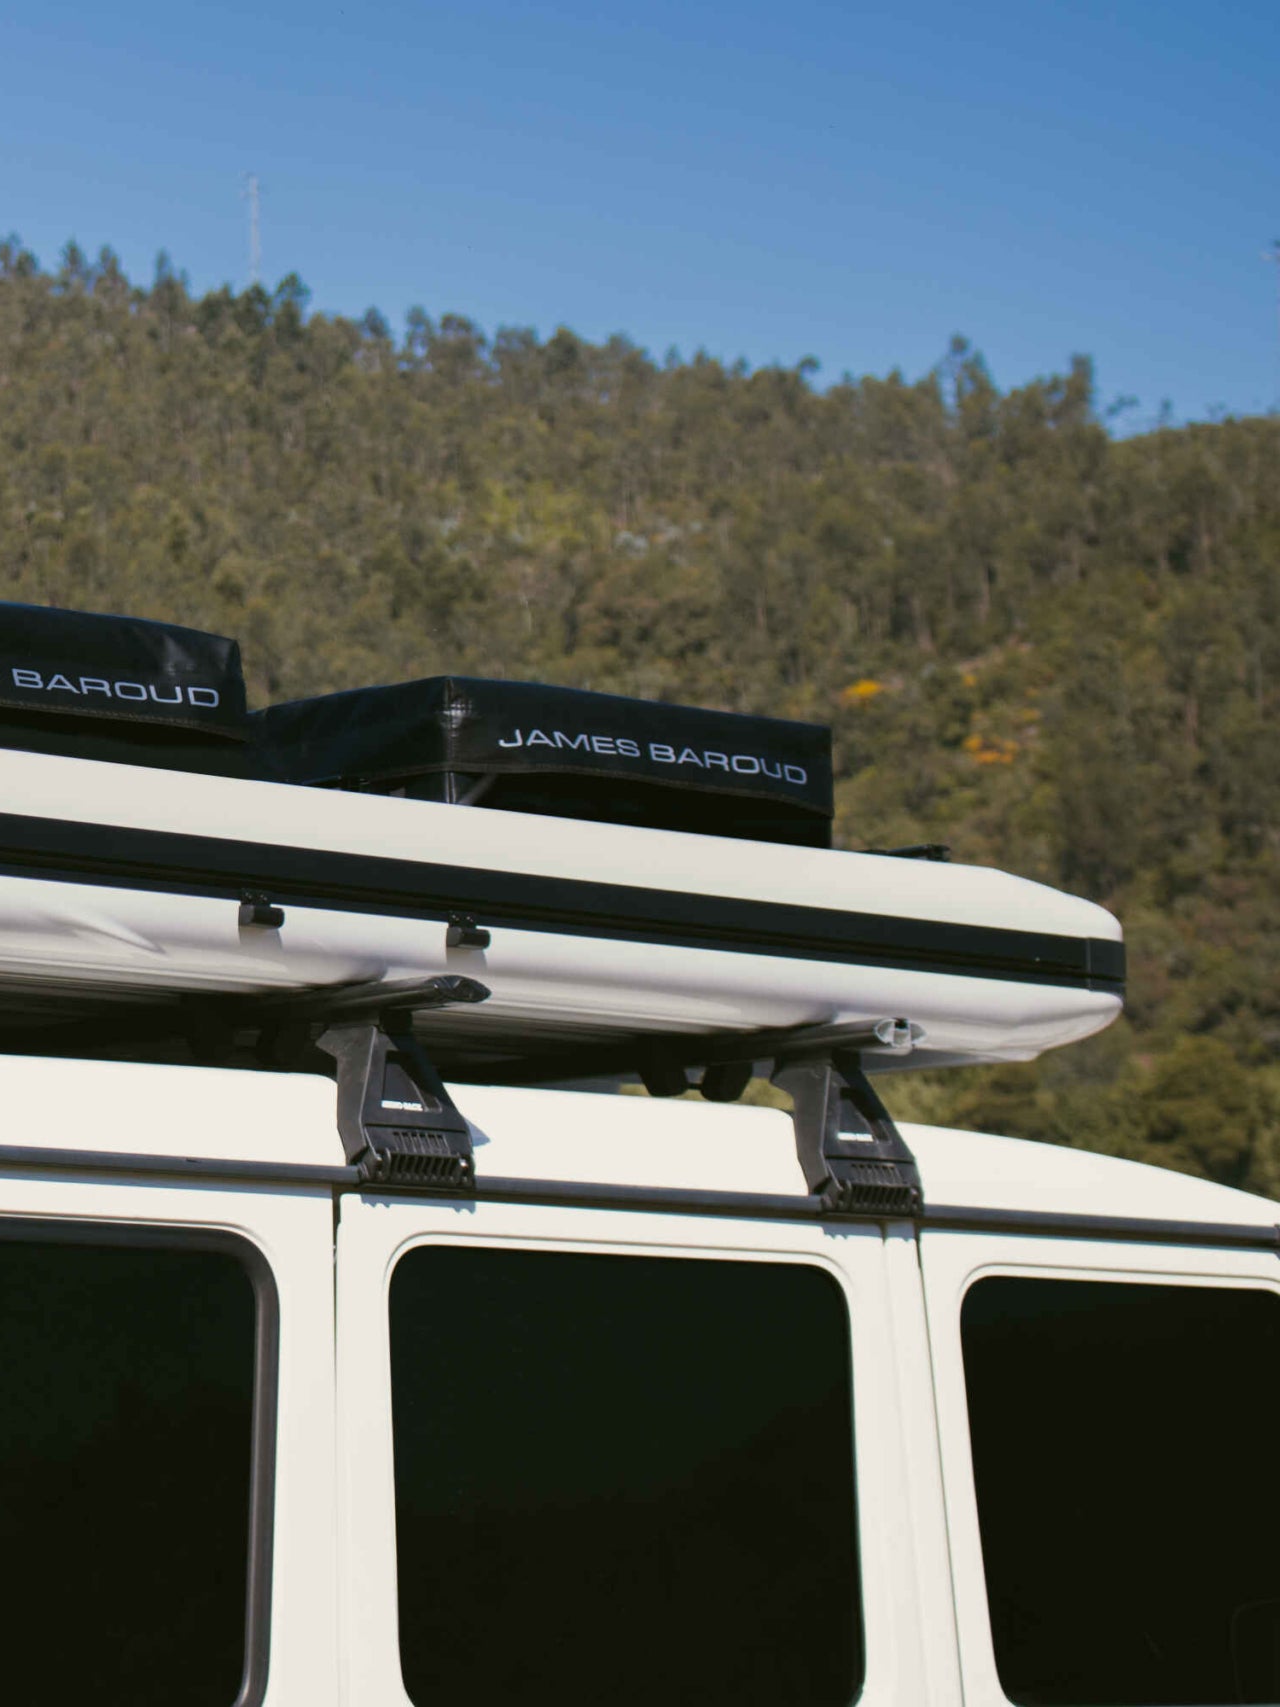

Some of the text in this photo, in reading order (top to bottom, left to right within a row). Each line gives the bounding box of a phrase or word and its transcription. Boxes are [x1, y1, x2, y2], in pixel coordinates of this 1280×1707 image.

[12, 668, 221, 708] BAROUD
[499, 729, 808, 784] JAMES BAROUD
